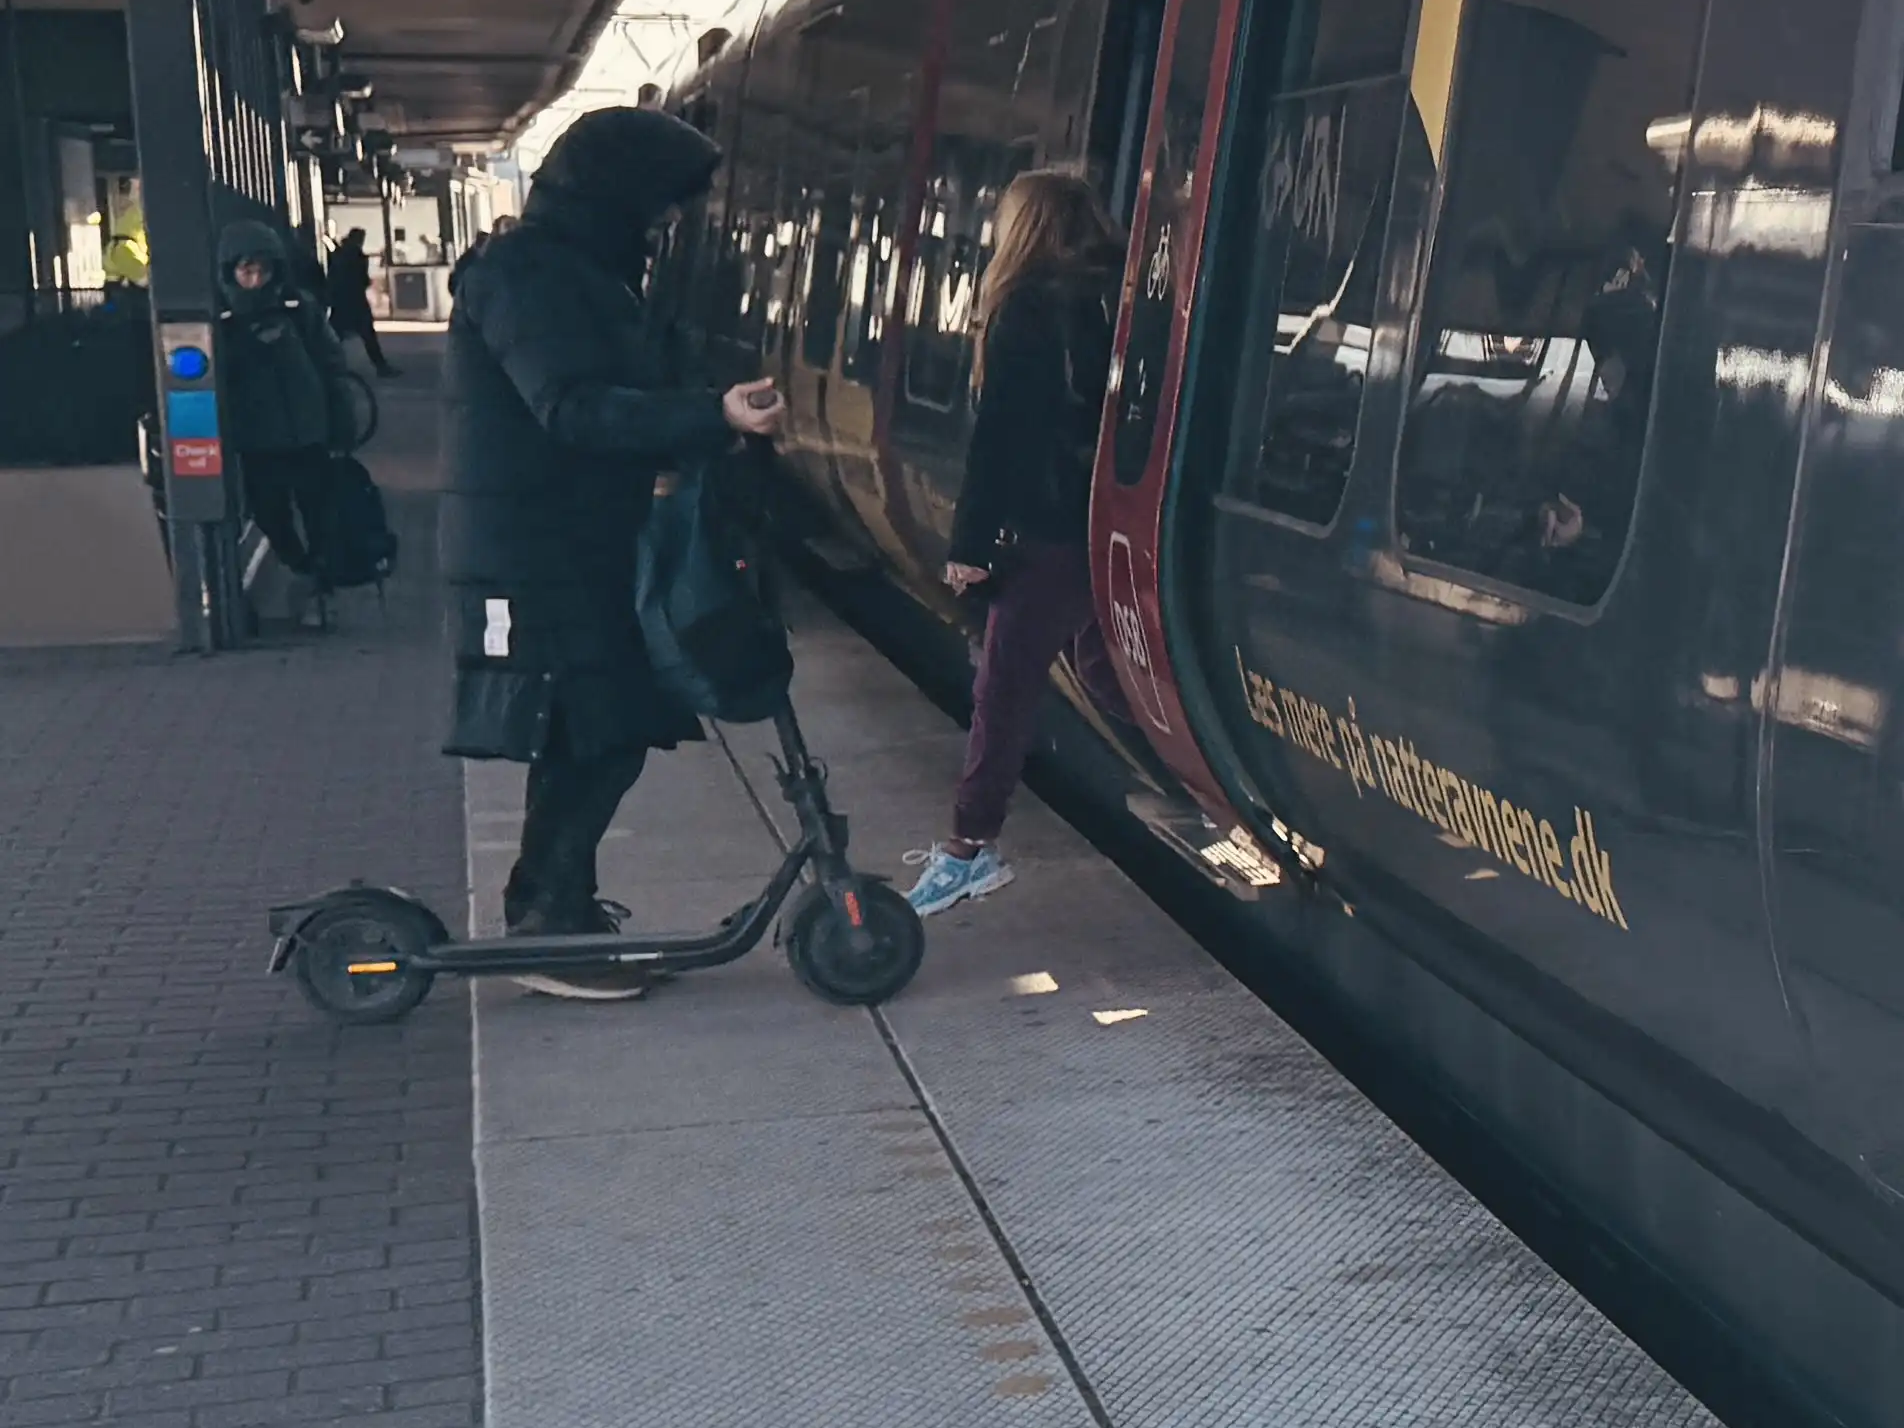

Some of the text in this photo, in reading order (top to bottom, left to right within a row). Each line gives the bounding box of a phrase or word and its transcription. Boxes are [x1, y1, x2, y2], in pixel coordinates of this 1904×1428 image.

[1278, 687, 1343, 770] mere
[1336, 694, 1378, 799] på
[1368, 733, 1630, 932] natteravnene.dk
